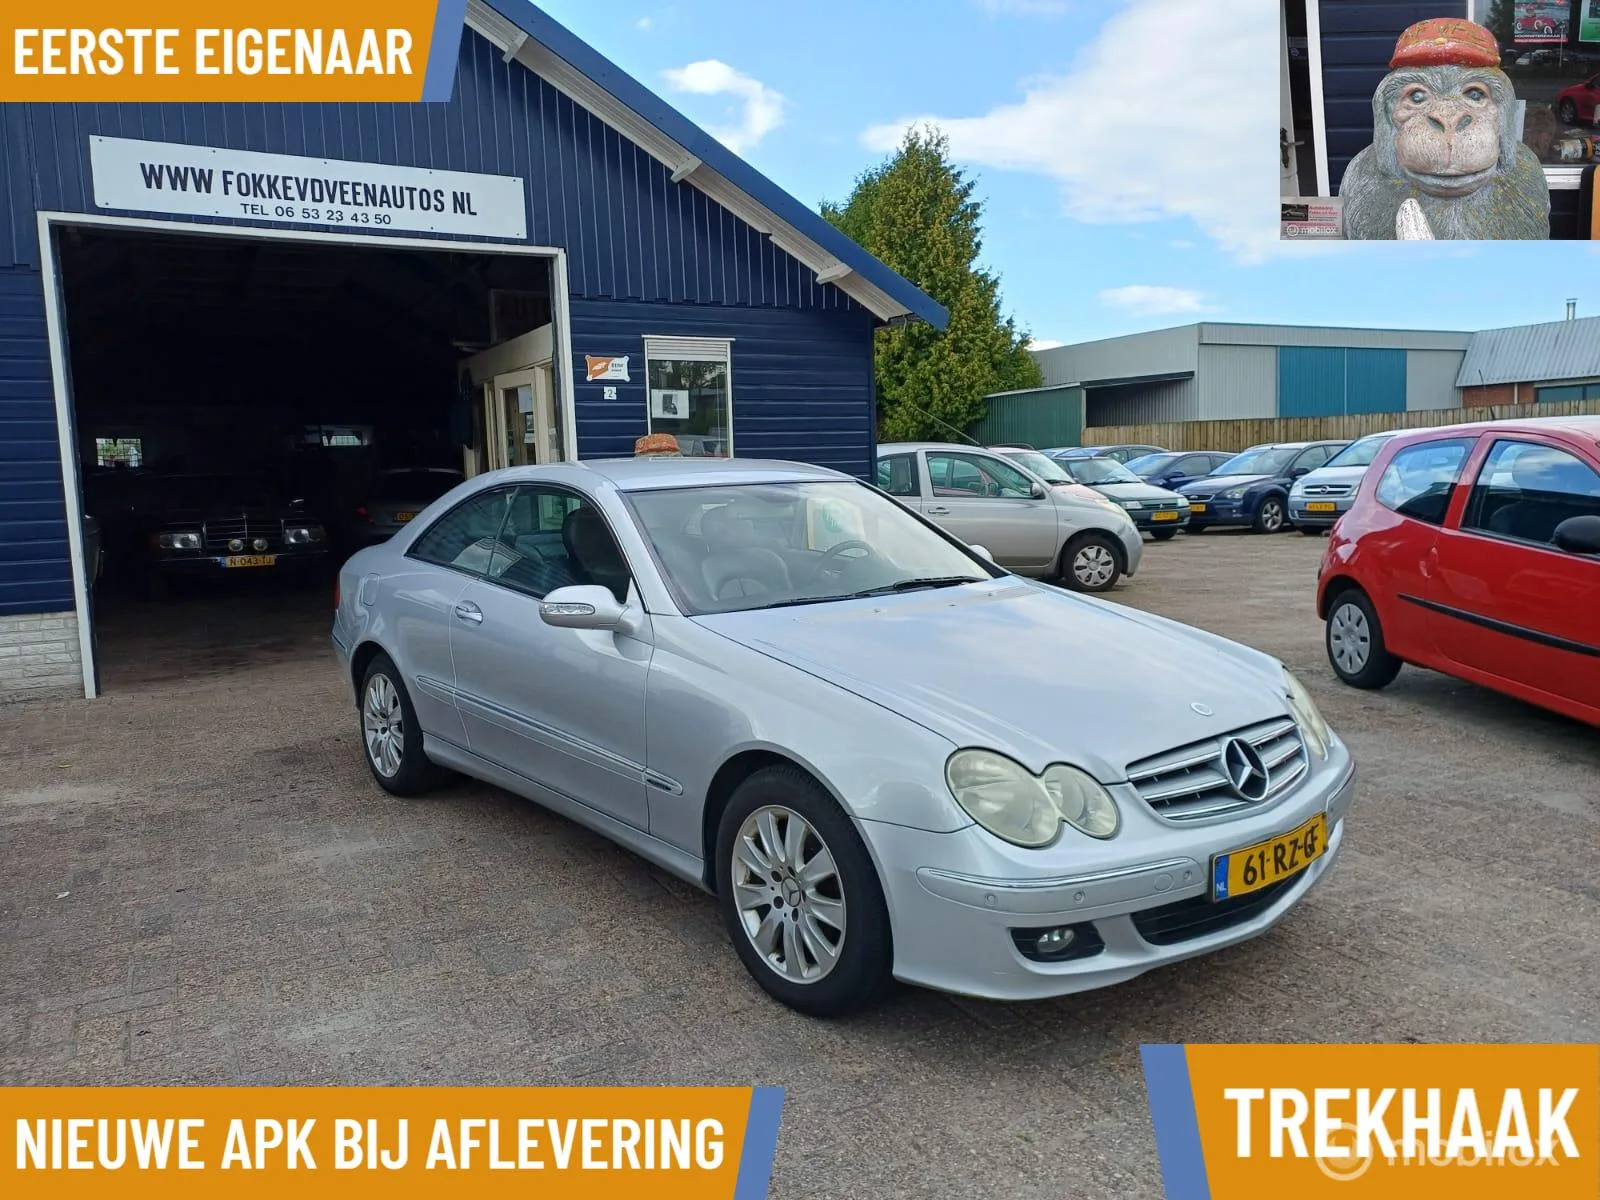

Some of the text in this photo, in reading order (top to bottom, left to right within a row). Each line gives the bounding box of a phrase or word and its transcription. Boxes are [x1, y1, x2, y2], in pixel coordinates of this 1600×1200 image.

[140, 162, 478, 216] WWW FOKKEVDVEENAUTOS NL
[240, 203, 392, 225] TEL 06 53 23 43 50
[1243, 823, 1320, 886] 61-RZ-GF
[1215, 881, 1227, 893] NL
